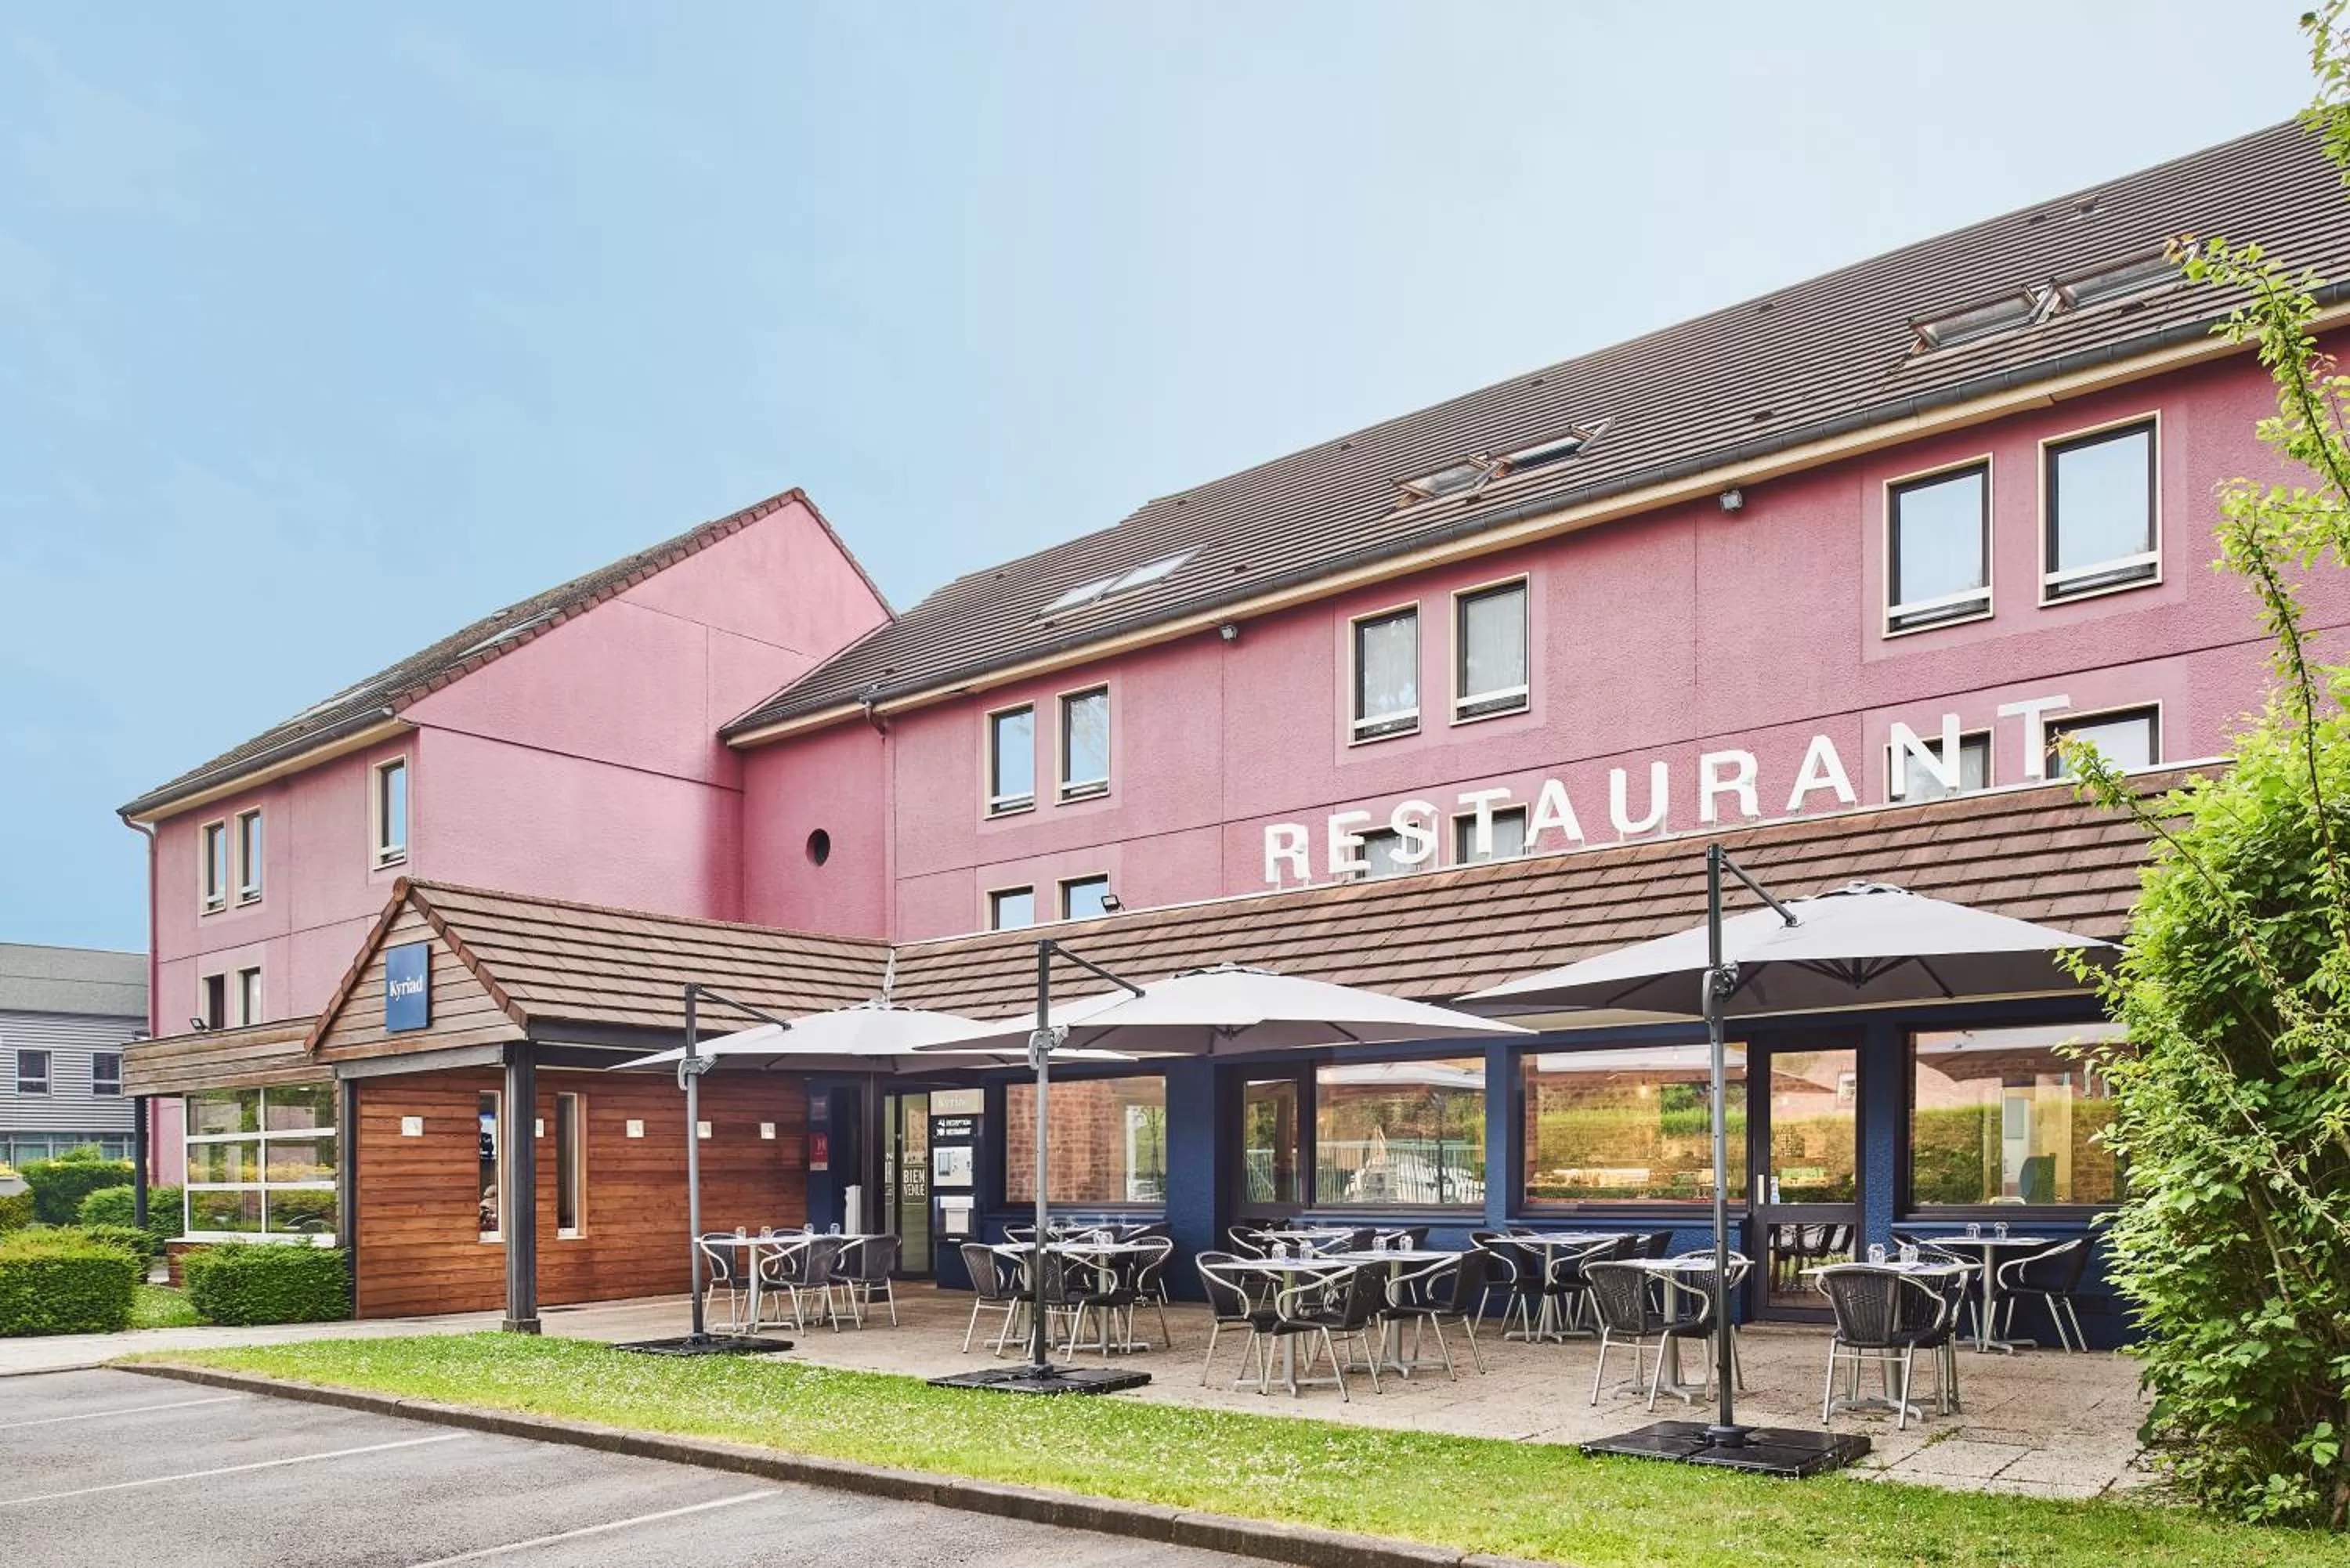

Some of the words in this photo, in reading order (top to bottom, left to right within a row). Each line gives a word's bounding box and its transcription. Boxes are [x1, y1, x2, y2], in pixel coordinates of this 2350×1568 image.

[1264, 694, 2071, 883] RESTAURANT
[389, 974, 423, 1002] Kyriad
[903, 1168, 925, 1183] BIEN
[903, 1183, 925, 1197] VENUE
